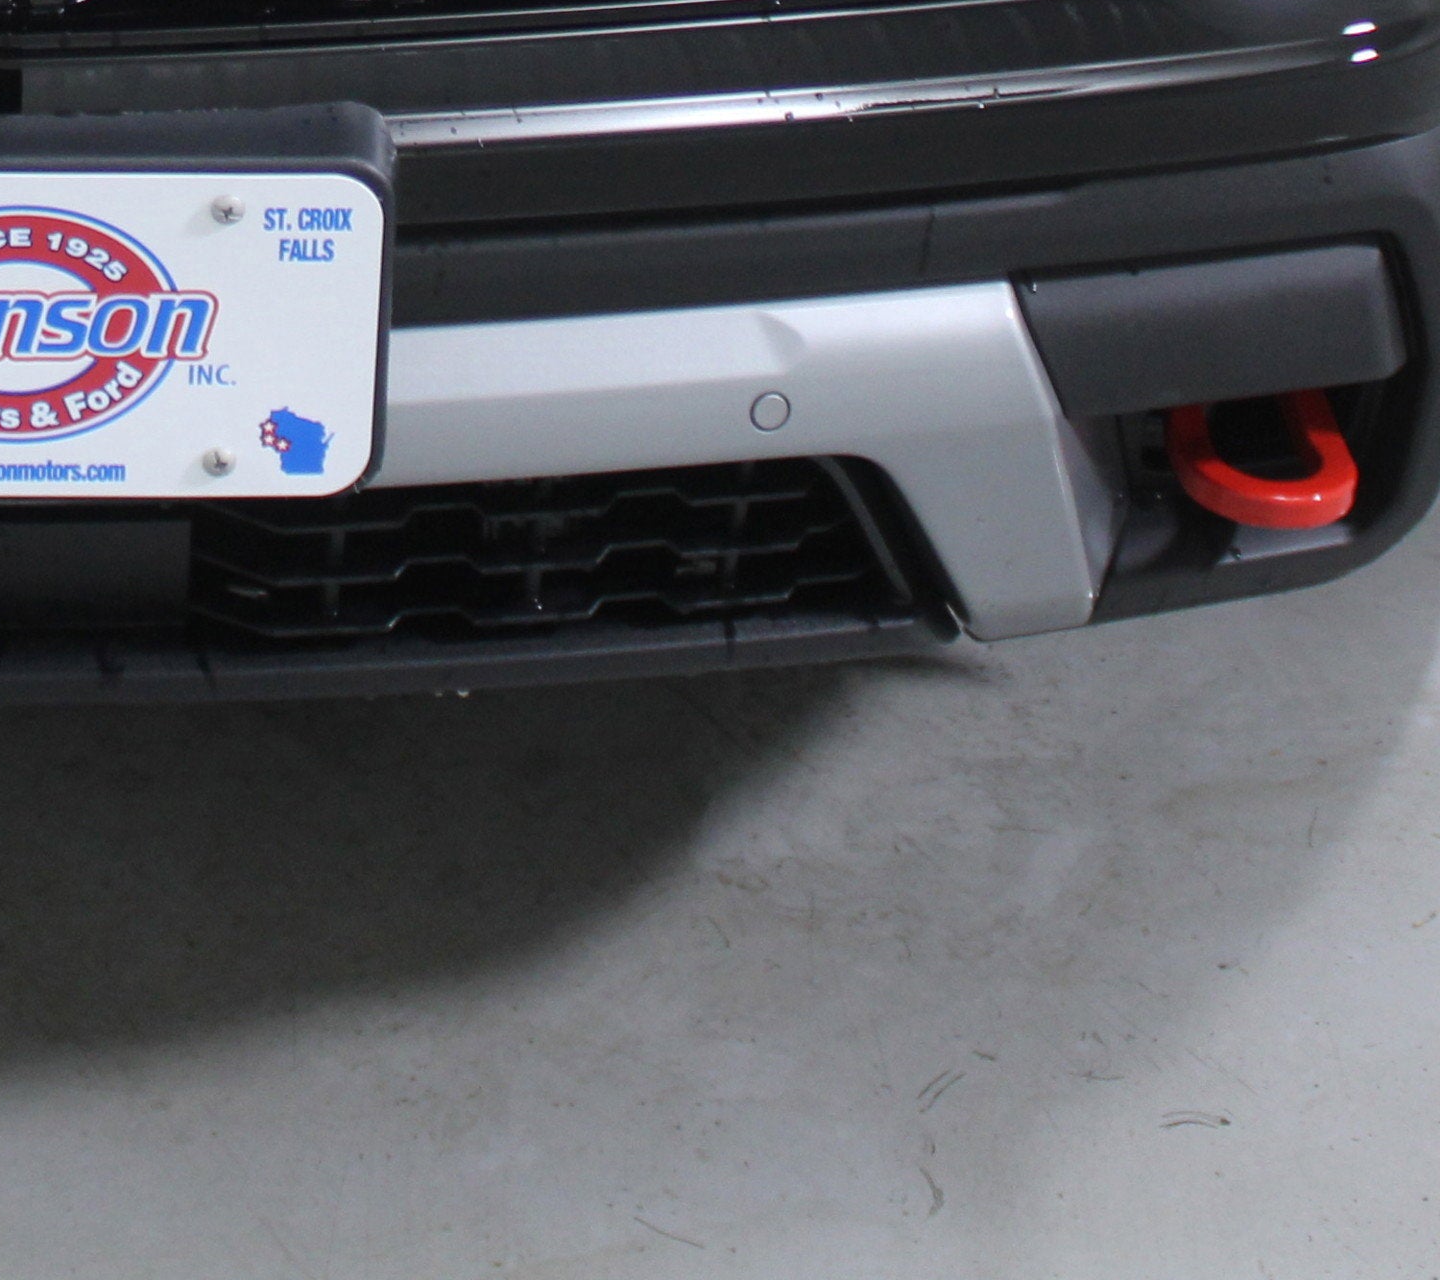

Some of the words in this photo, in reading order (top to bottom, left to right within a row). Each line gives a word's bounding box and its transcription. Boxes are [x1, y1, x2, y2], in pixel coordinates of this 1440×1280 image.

[263, 207, 292, 231] ST.
[297, 207, 353, 232] CROIX
[46, 231, 129, 282] 1925
[278, 237, 335, 262] FALLS
[187, 363, 237, 386] INC.
[30, 398, 59, 430] &
[63, 362, 143, 424] Ford
